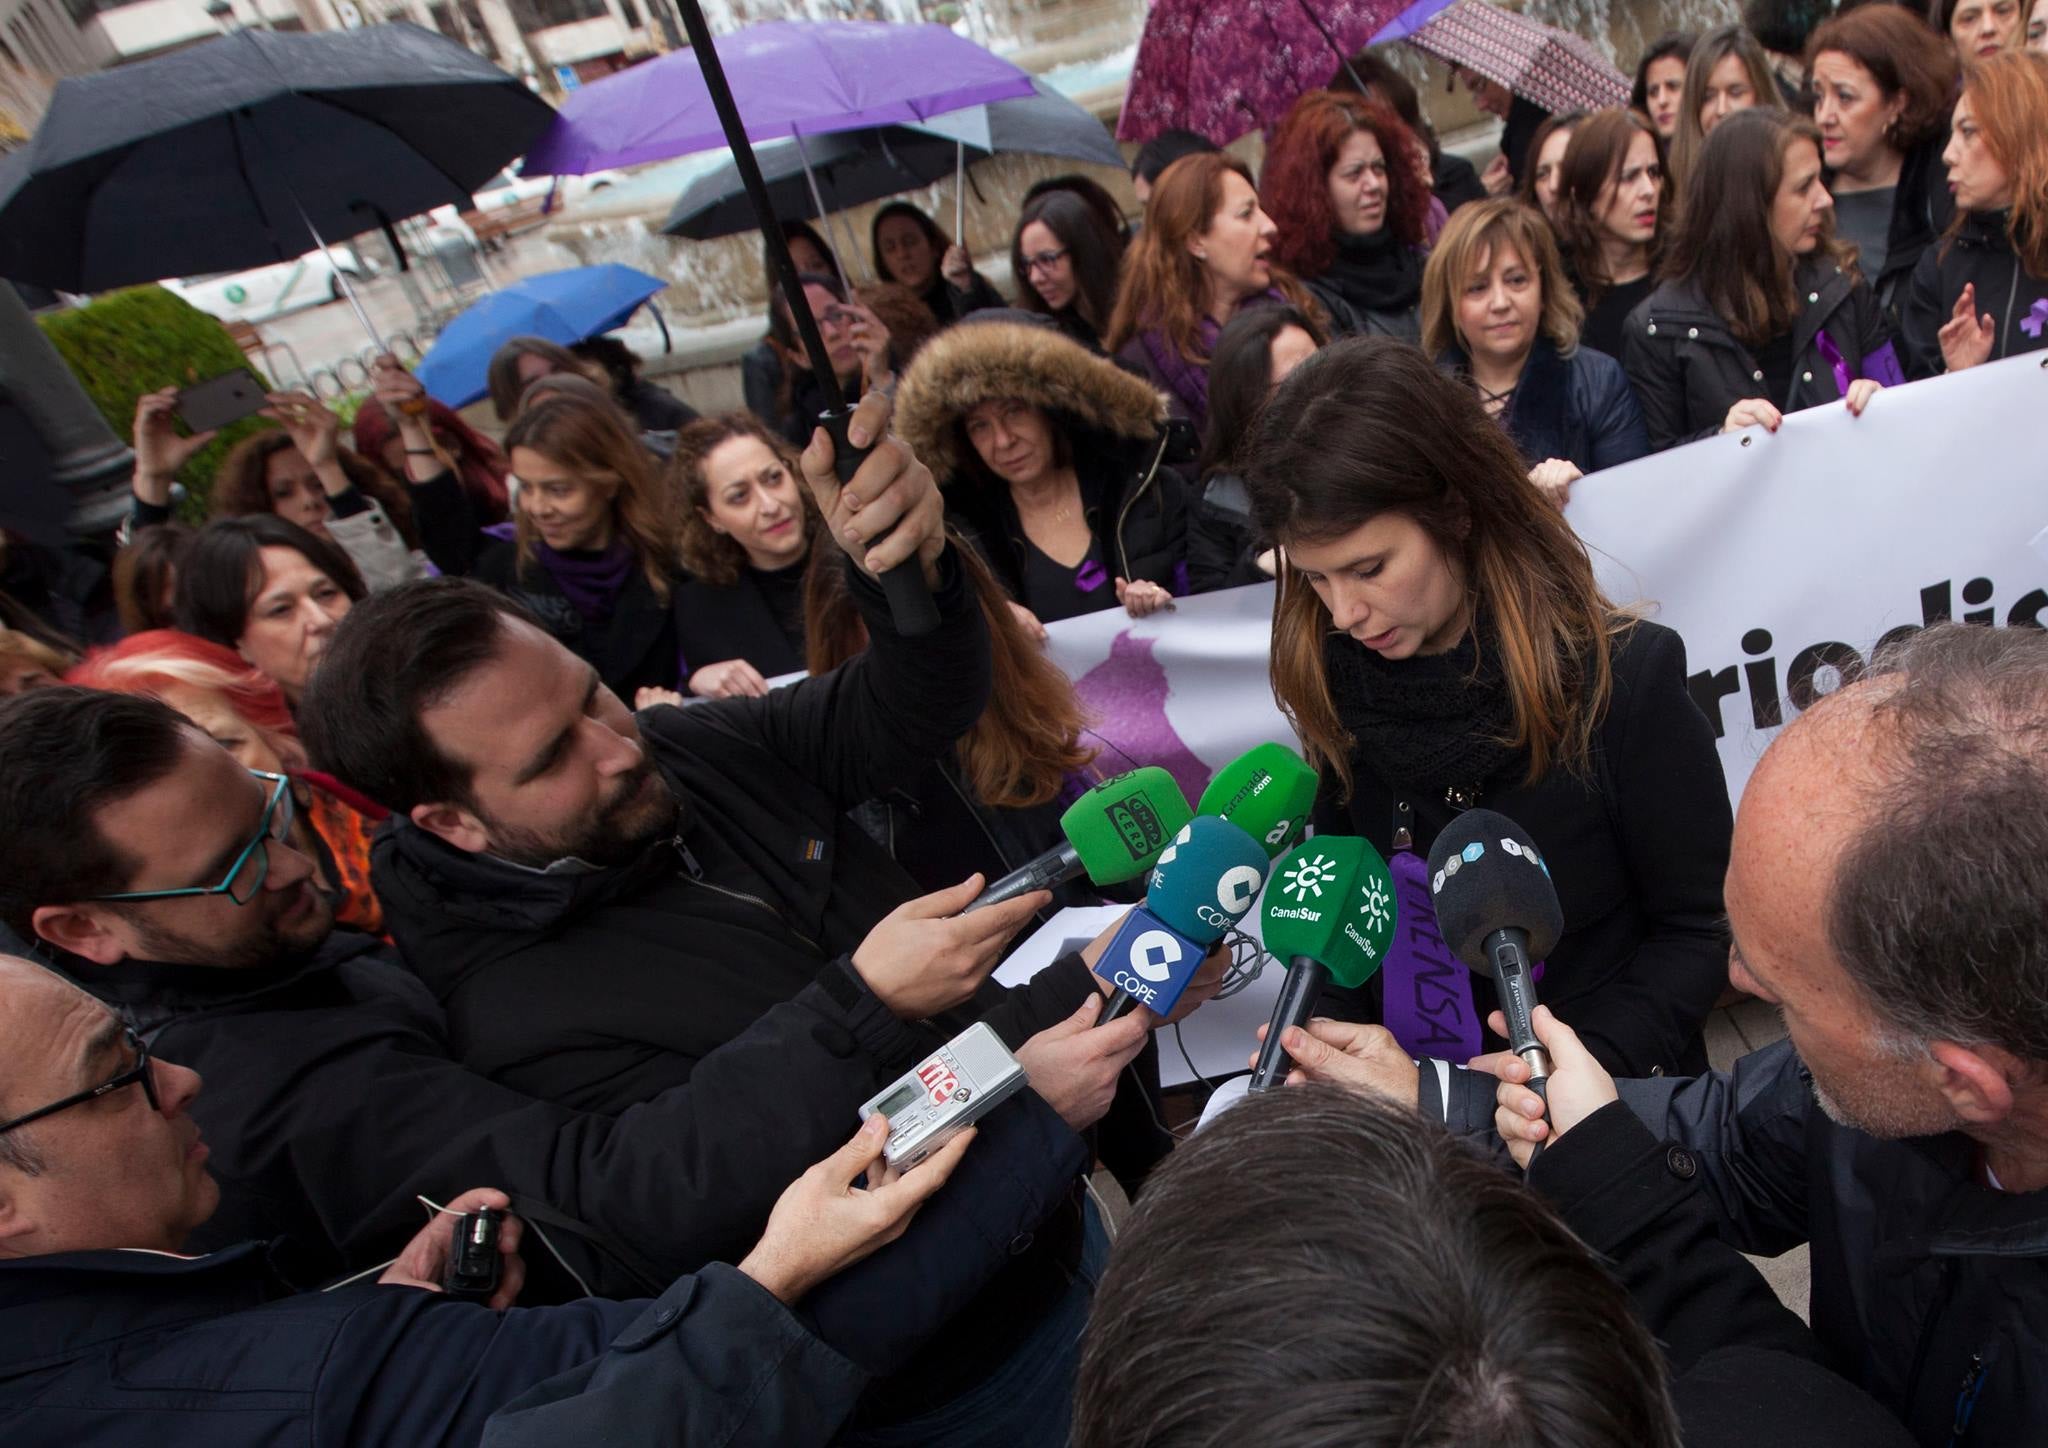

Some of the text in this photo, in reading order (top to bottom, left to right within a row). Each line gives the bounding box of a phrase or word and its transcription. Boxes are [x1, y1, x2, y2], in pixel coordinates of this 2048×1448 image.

[1253, 774, 1273, 797] .com
[1117, 810, 1146, 852] CERO
[1132, 801, 1160, 843] ONDA
[1196, 905, 1236, 931] COPE
[1270, 905, 1322, 922] CanalSur
[1344, 922, 1377, 959] CanalSur
[1112, 969, 1158, 1006] COPE
